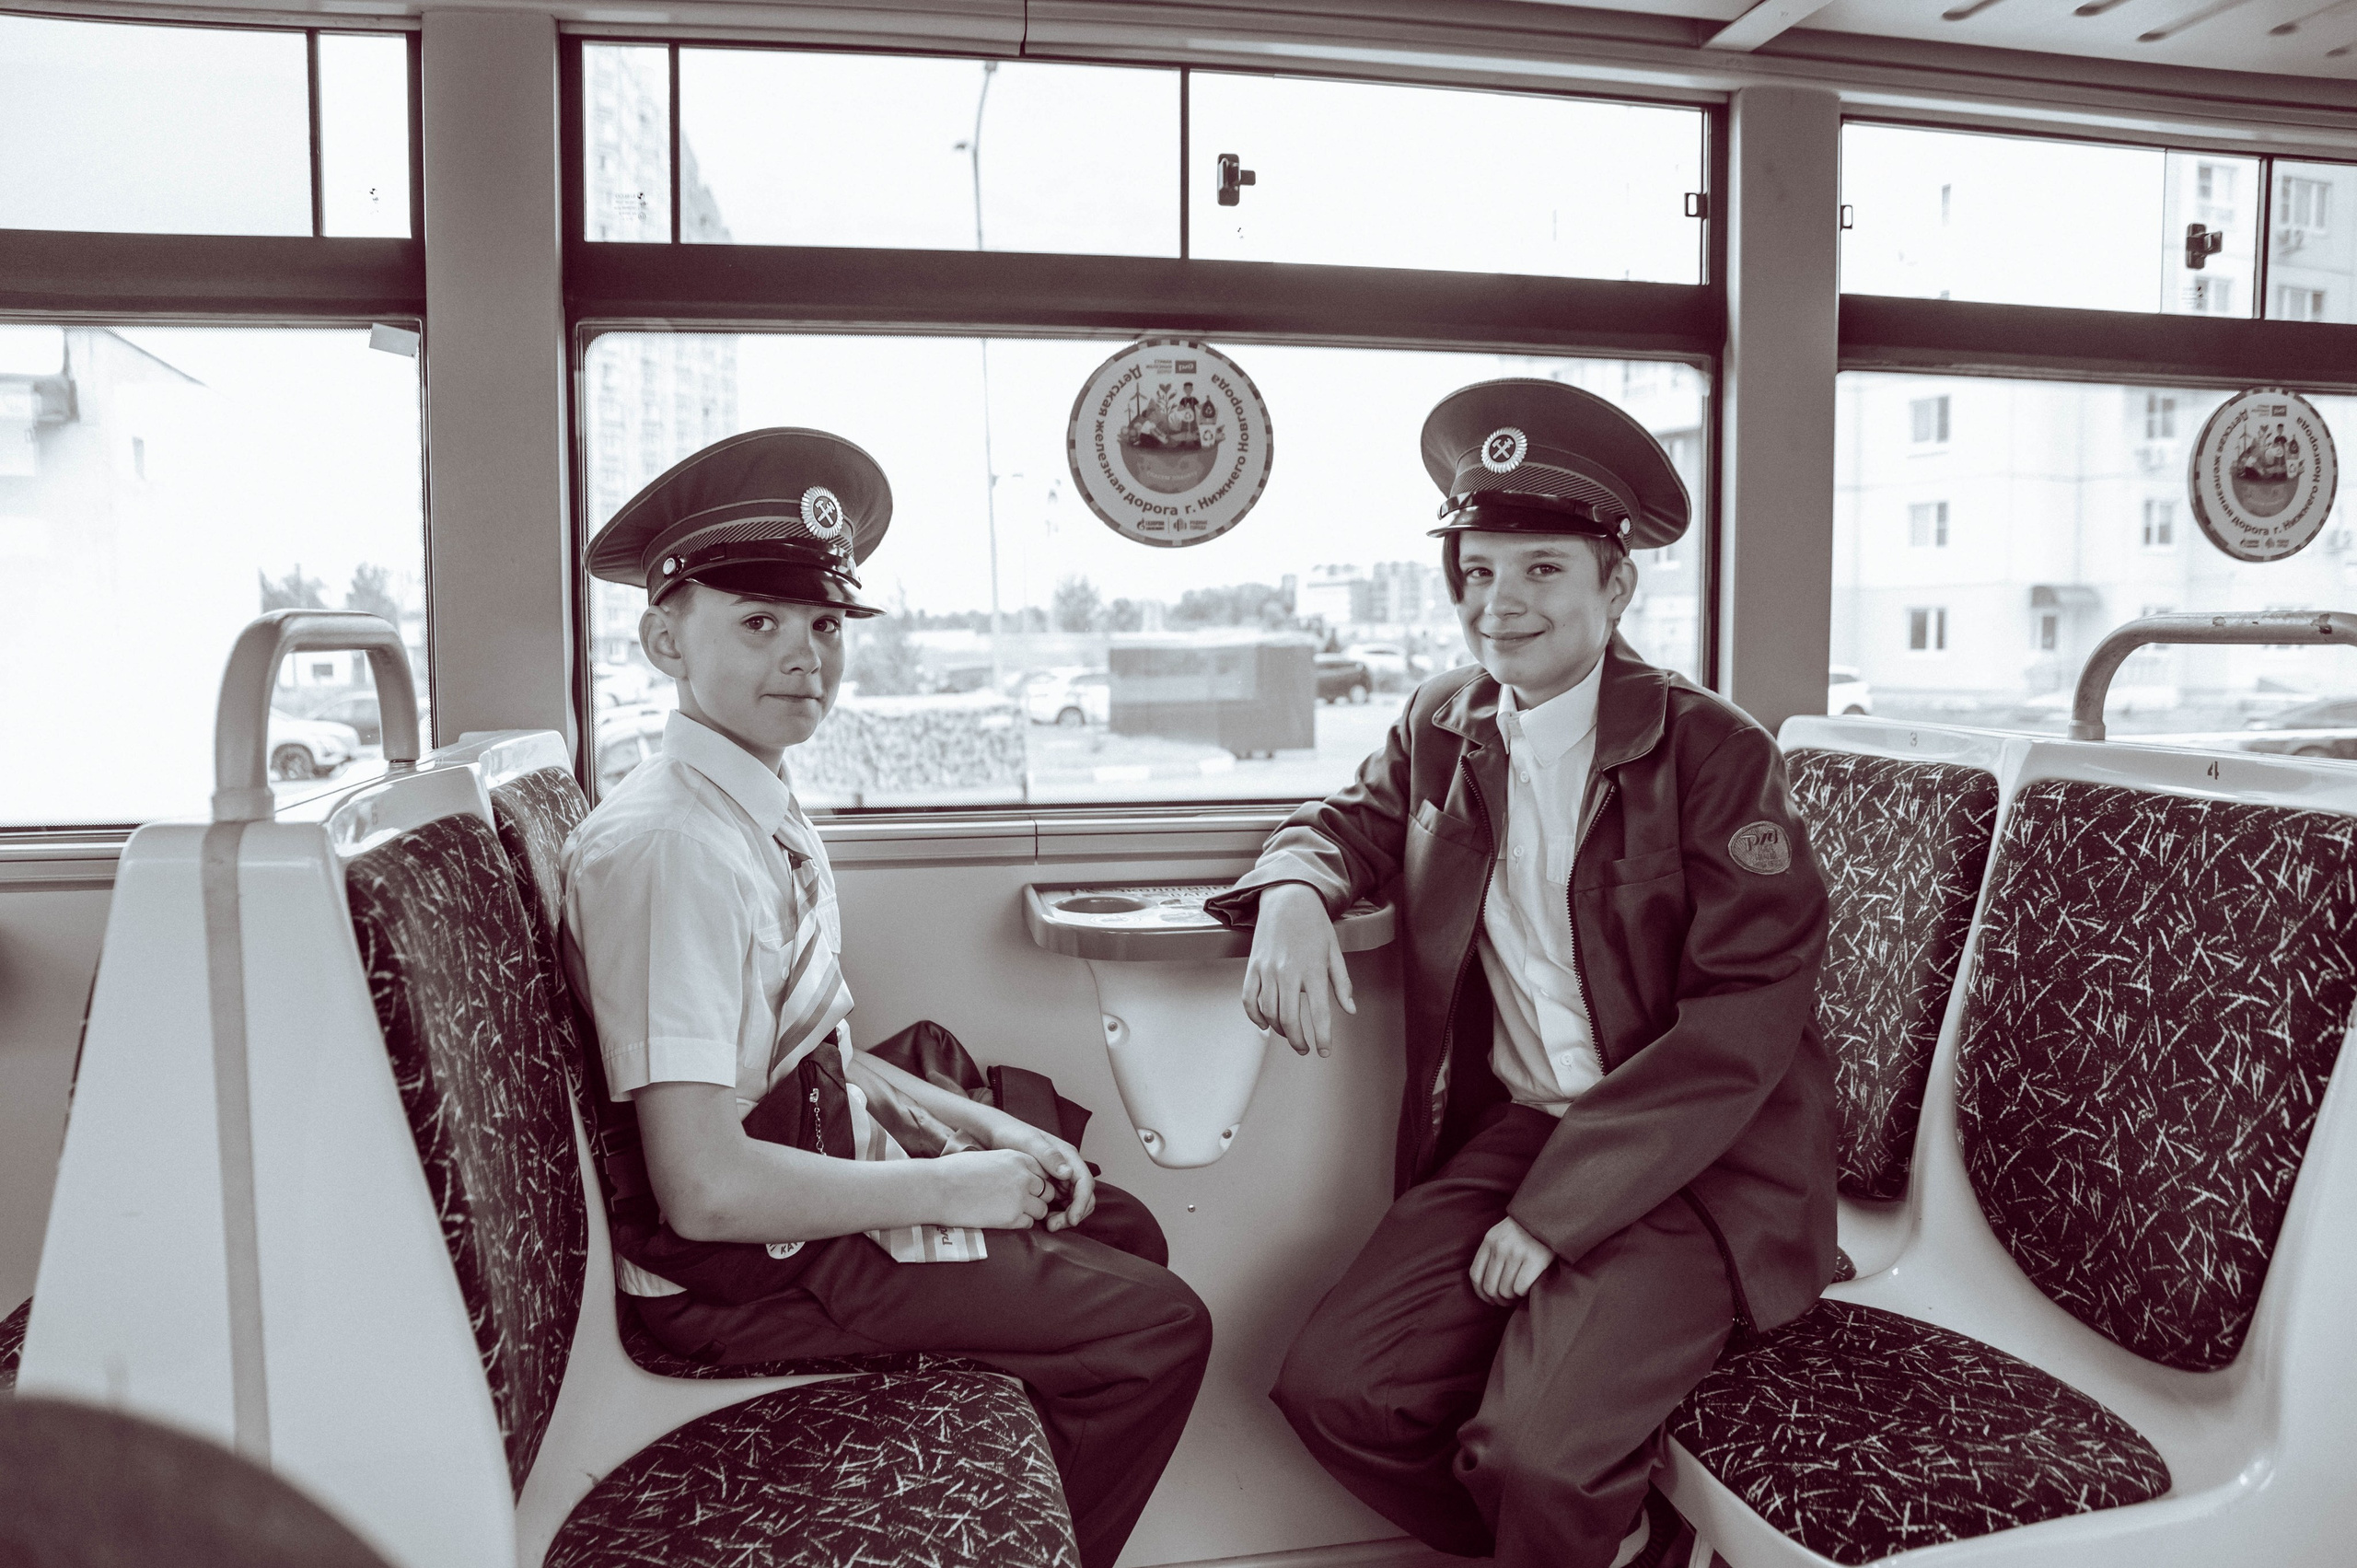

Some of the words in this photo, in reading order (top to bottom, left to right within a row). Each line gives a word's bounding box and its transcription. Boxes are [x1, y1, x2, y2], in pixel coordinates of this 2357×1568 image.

[1098, 364, 1143, 417] Детская
[1211, 373, 1249, 452] Новгорода
[1095, 419, 1126, 494] железная
[1197, 455, 1247, 509] Нижнего
[2232, 517, 2270, 535] дорога
[2273, 527, 2282, 535] г.
[2296, 416, 2322, 482] Новгорода
[1123, 492, 1178, 516] дорога
[1185, 505, 1196, 515] г.
[2207, 761, 2220, 781] 4
